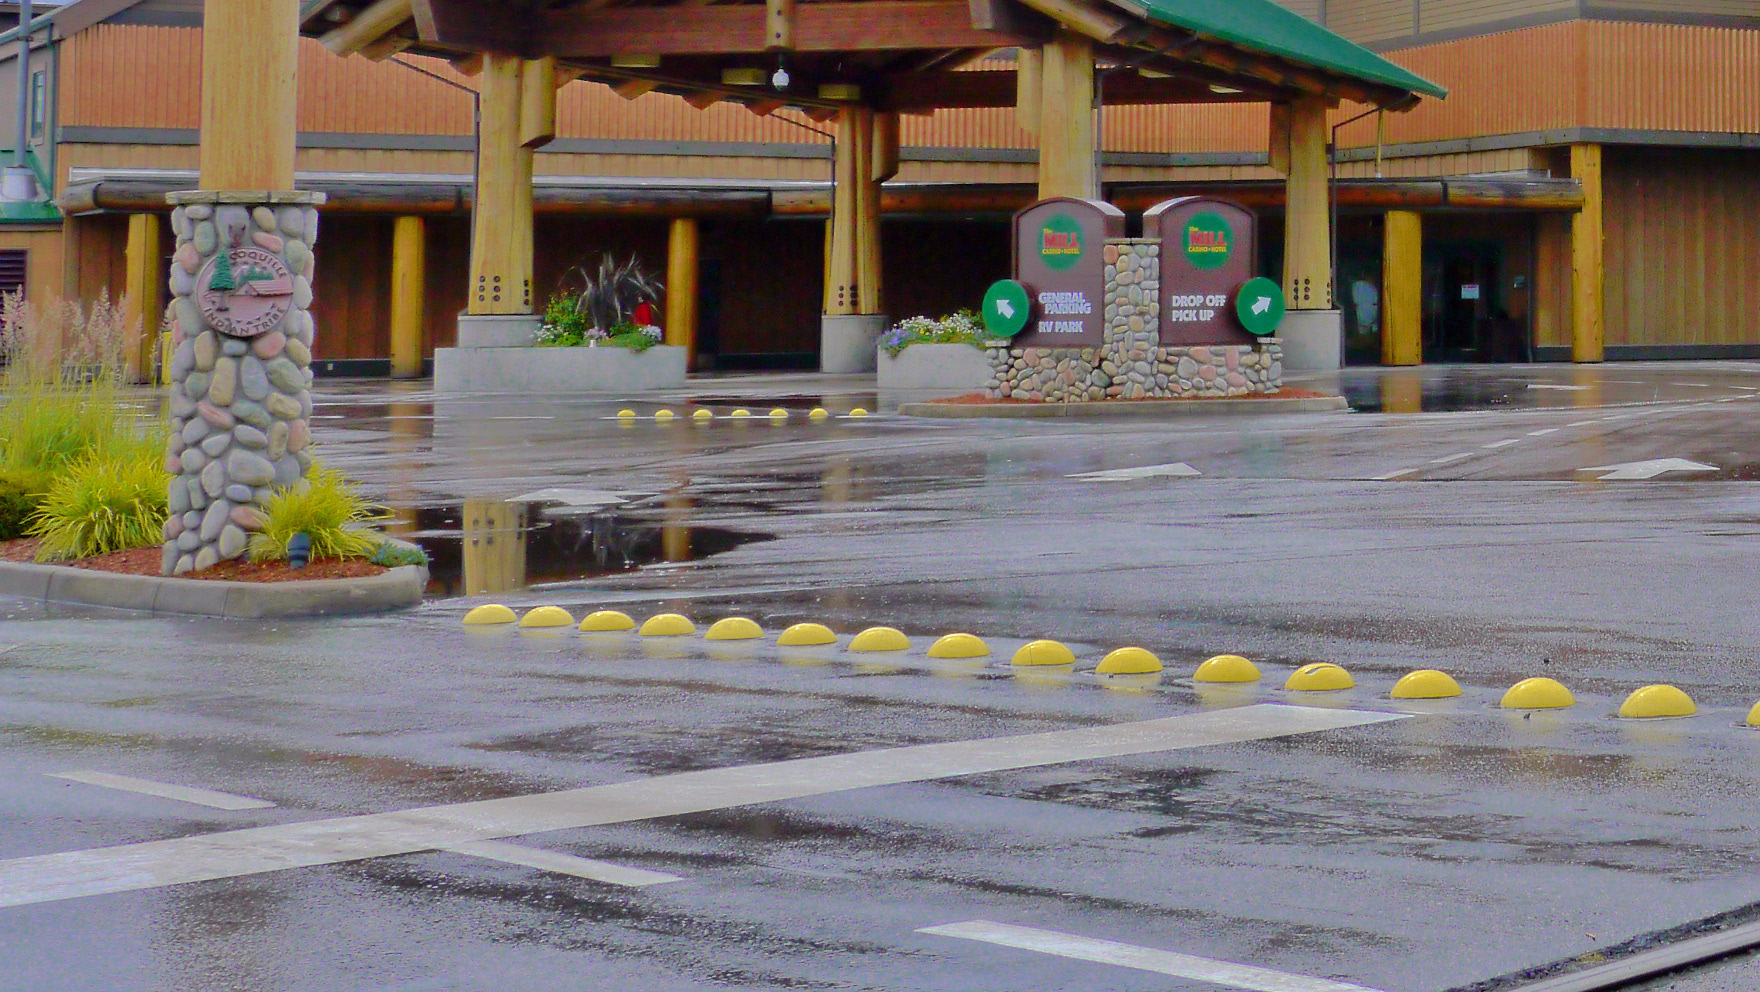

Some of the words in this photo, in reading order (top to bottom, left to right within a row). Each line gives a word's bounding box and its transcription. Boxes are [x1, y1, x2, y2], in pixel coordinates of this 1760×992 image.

[1043, 232, 1080, 248] MILL
[1189, 231, 1228, 246] MILL
[230, 250, 287, 279] COQUILLE
[1038, 291, 1086, 304] GENERAL
[1172, 295, 1204, 307] DROP
[1205, 294, 1227, 307] OFF
[1044, 302, 1092, 315] PARKING
[1172, 309, 1197, 321] PICK
[1199, 309, 1215, 321] UP
[204, 307, 251, 335] INDIAN
[253, 306, 286, 332] TRIBE
[1038, 320, 1054, 333] RV
[1054, 320, 1084, 333] PARK
